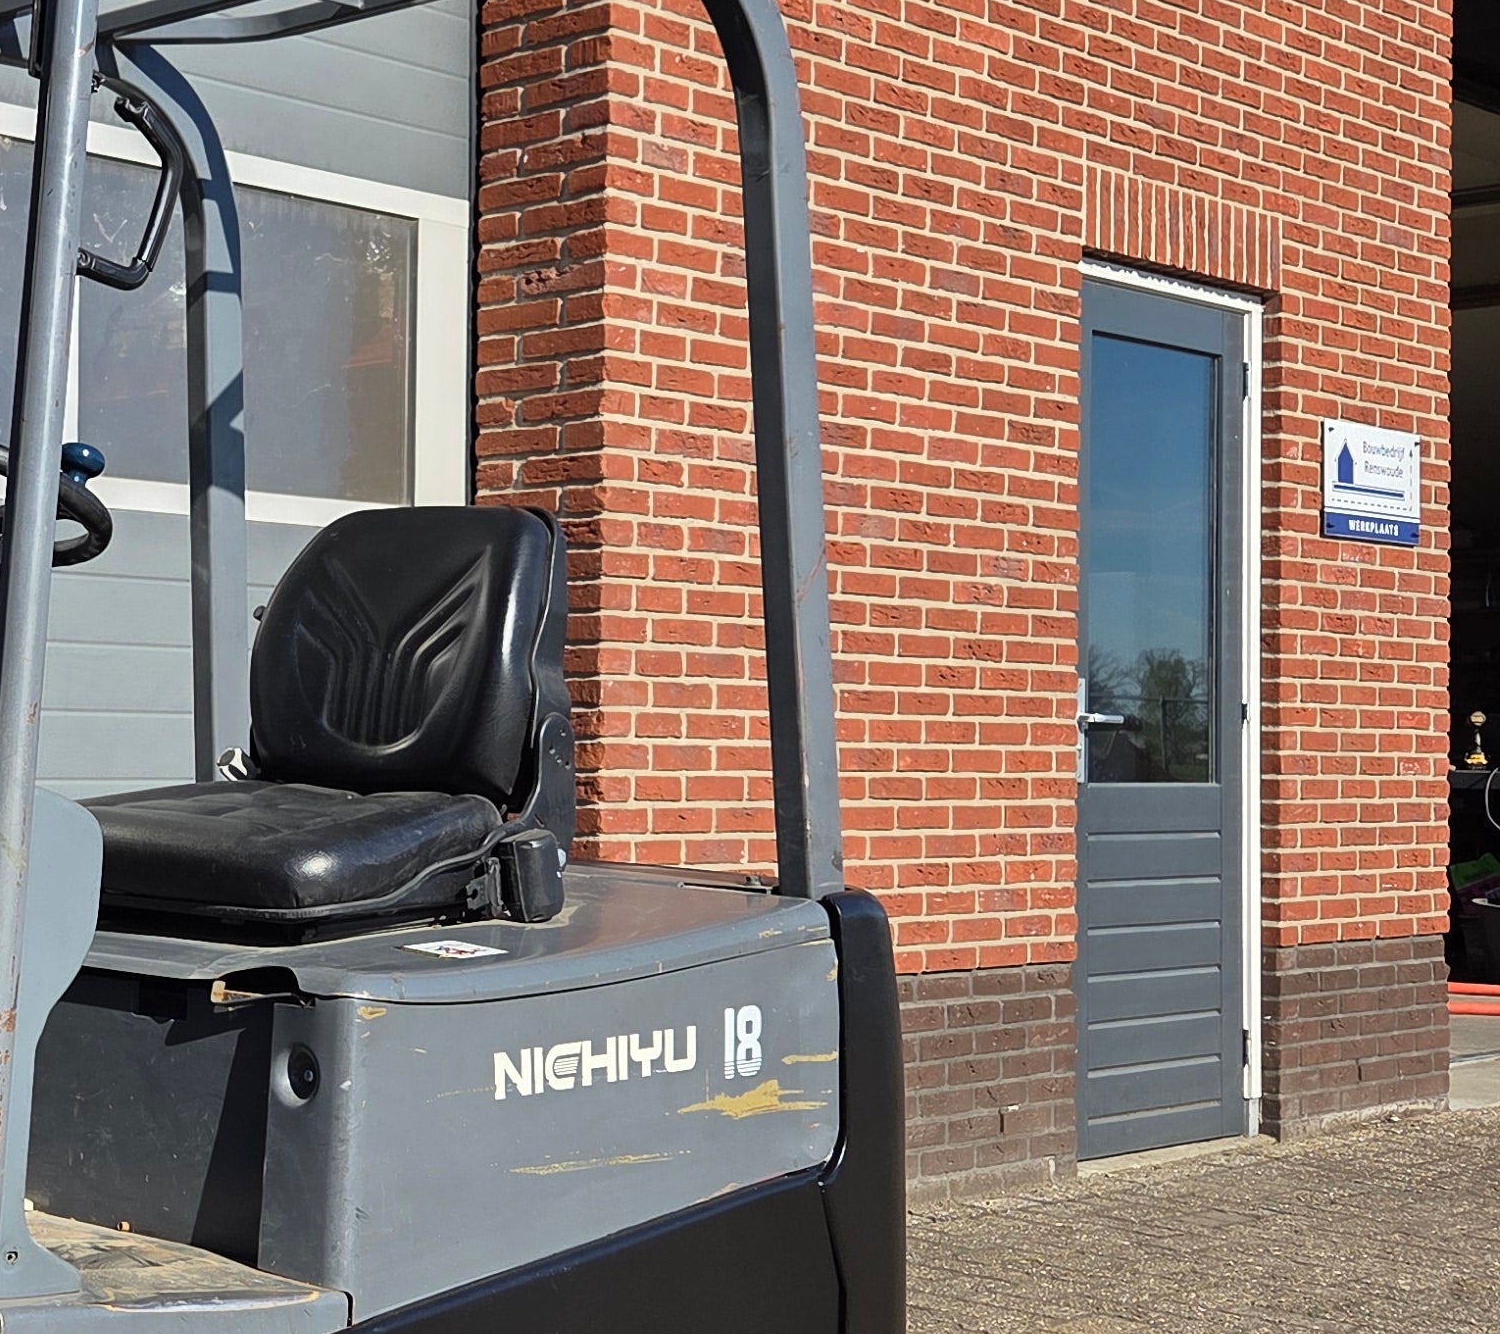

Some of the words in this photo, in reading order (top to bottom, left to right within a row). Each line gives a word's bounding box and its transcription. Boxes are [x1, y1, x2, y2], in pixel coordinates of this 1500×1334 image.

[1348, 519, 1400, 537] WERKPLAATS
[493, 1025, 697, 1101] NICHIYU
[723, 1004, 763, 1079] 18
